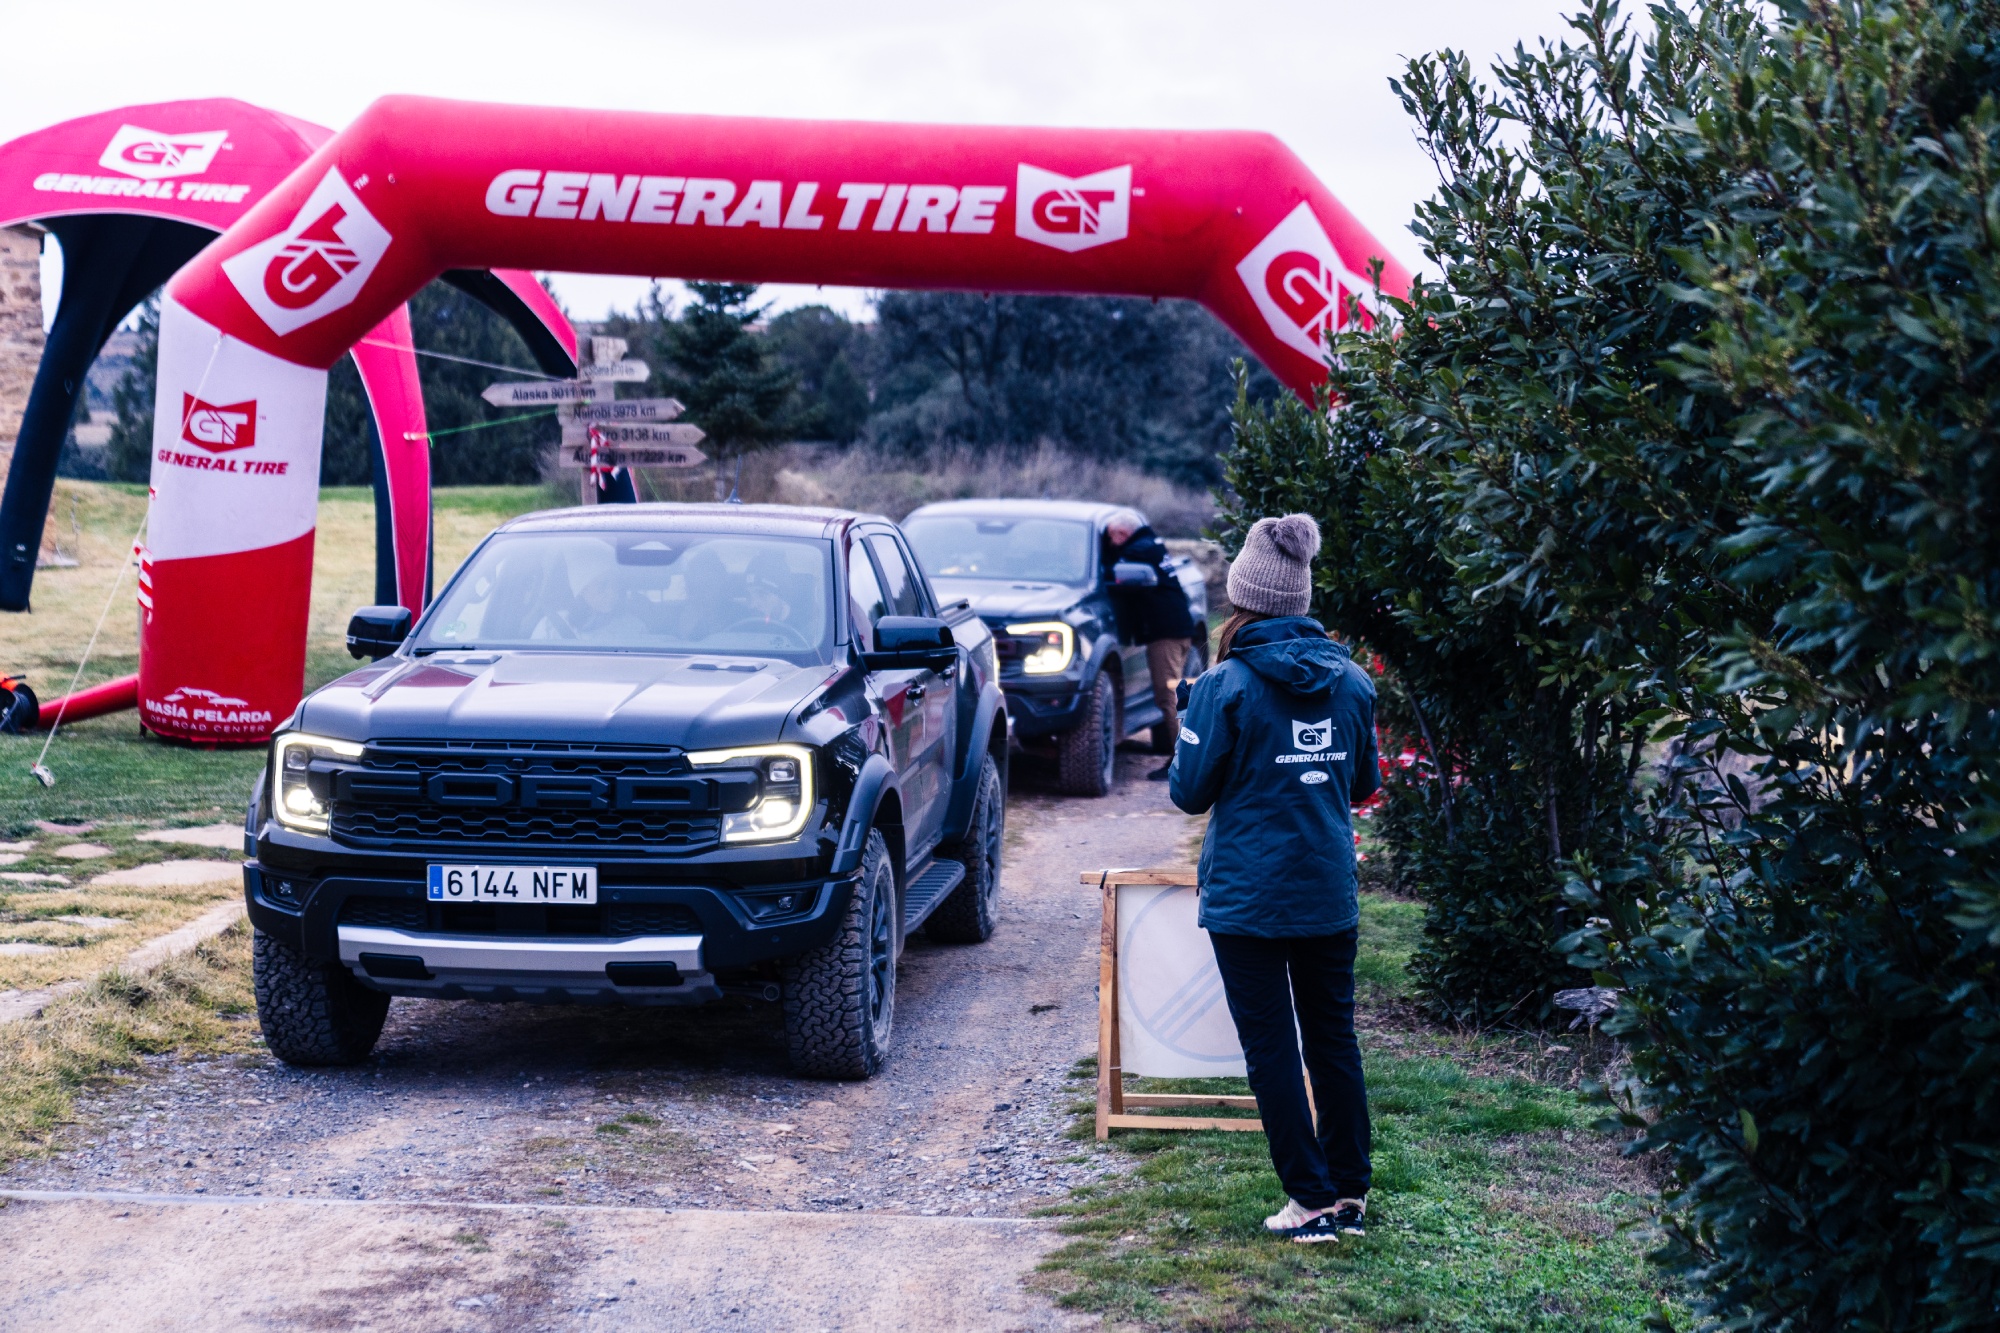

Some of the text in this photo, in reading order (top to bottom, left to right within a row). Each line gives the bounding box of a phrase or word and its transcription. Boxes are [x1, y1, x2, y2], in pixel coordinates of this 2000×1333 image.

[121, 141, 205, 168] GT
[33, 172, 250, 203] GENERAL TIRE
[485, 168, 1007, 234] GENERAL TIRE
[1032, 189, 1115, 234] GT
[512, 389, 548, 401] Alaska
[640, 404, 656, 417] km
[190, 409, 249, 445] GT
[652, 428, 670, 441] km
[243, 460, 289, 475] TIRE
[193, 708, 272, 723] PELARDA
[172, 720, 207, 732] ROAD
[213, 724, 266, 733] CENTER
[1298, 727, 1327, 746] GT
[1275, 751, 1348, 764] GENERAL TIRE
[338, 769, 708, 812] FORD
[447, 870, 588, 899] 6144 NFM
